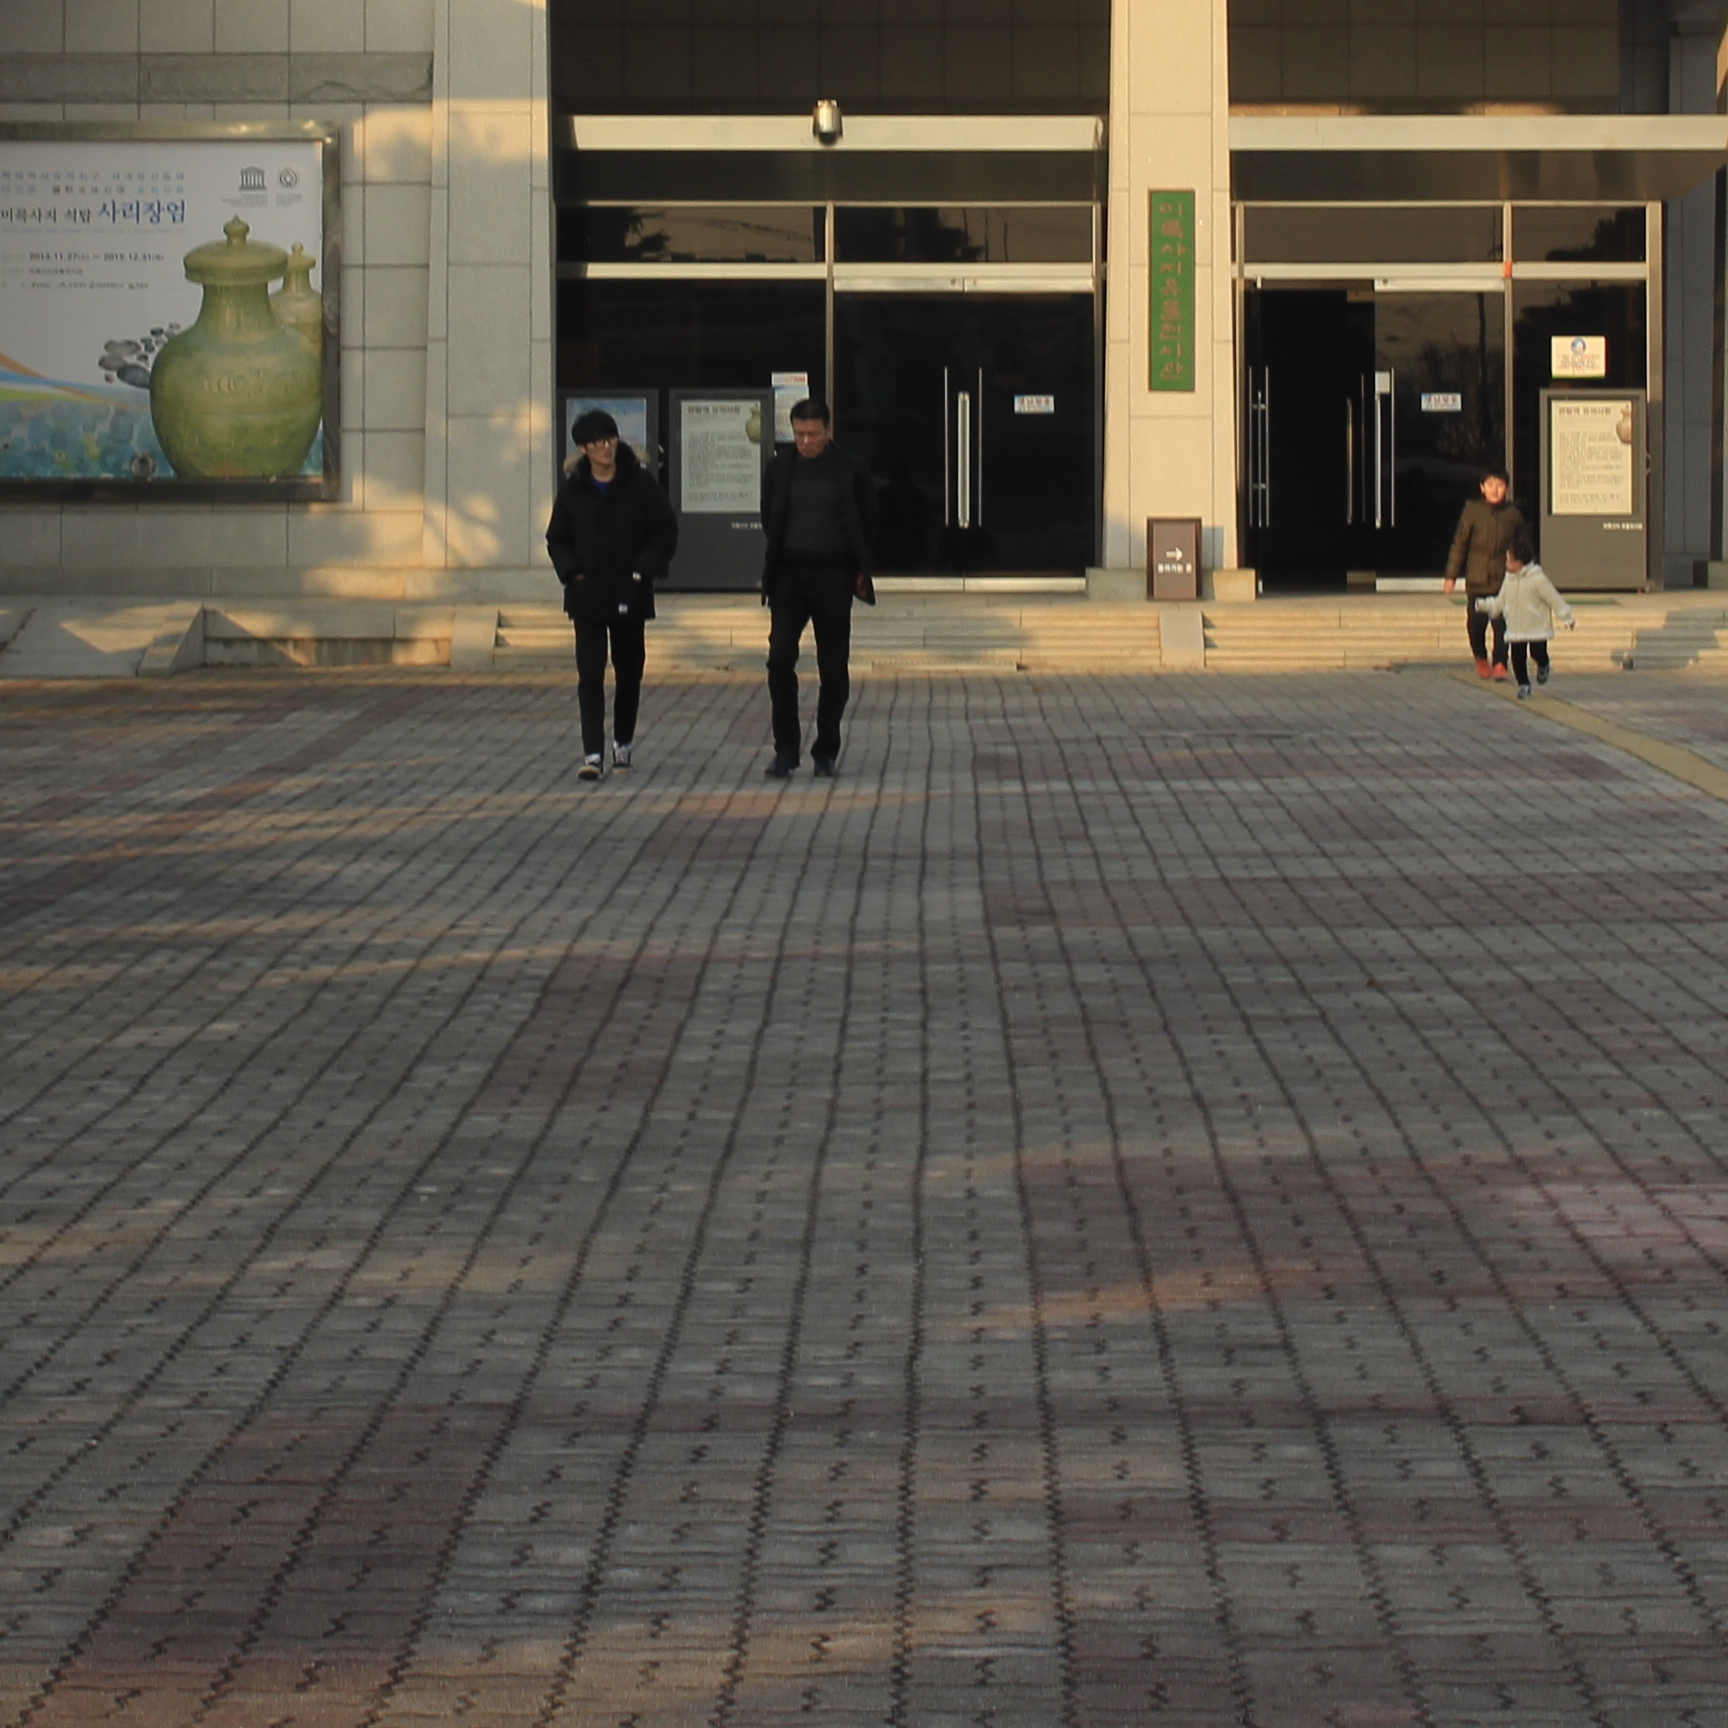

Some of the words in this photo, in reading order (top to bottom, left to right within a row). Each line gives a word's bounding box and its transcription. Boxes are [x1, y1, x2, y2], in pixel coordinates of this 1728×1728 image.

[0, 207, 57, 223] 미륵사지
[65, 207, 91, 223] 석탑
[98, 198, 185, 224] 사리장엄
[1159, 201, 1186, 381] 미륵사지유물전시관
